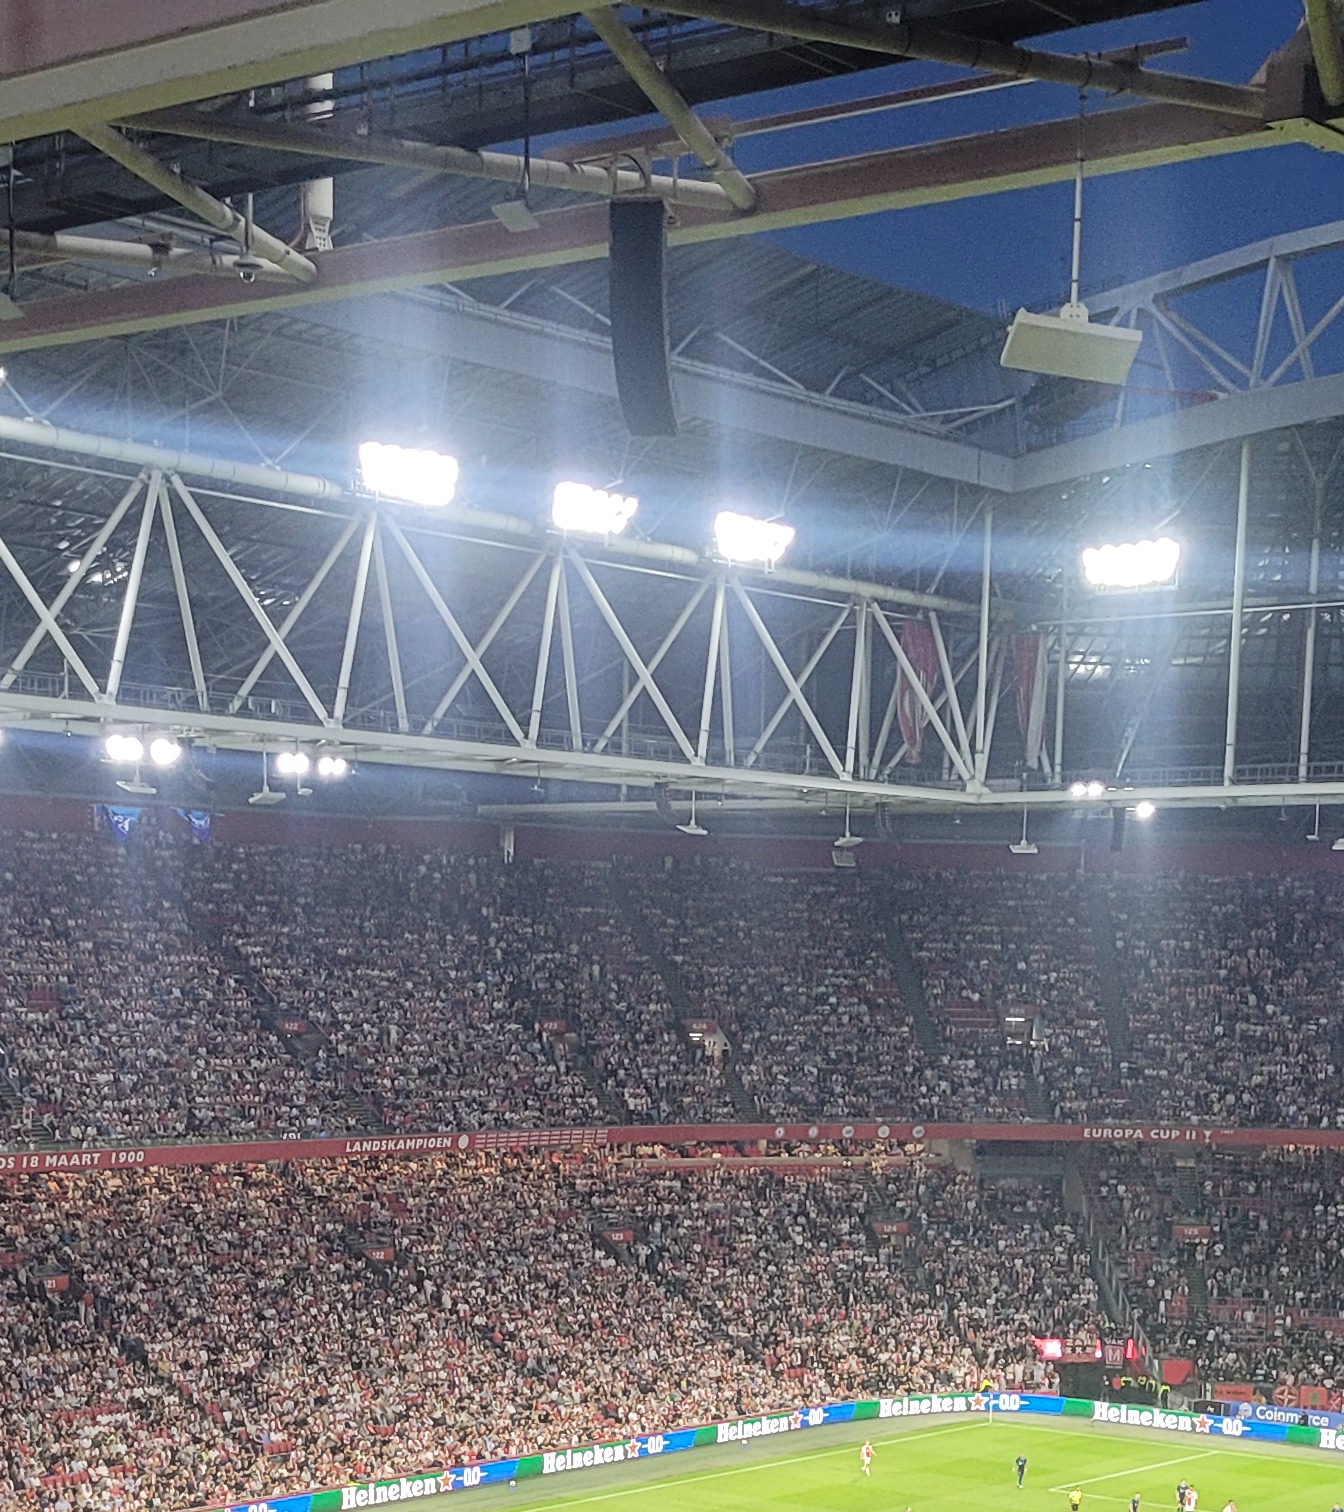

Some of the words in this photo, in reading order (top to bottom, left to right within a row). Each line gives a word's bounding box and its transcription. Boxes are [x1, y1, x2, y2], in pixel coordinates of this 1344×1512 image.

[345, 1136, 452, 1153] LANDSKAMPIOEN
[1083, 1128, 1144, 1139] EUROPA
[1150, 1129, 1180, 1140] CUP
[20, 1154, 40, 1170] 18
[44, 1152, 102, 1168] MAART
[110, 1150, 146, 1165] 1900
[878, 1394, 966, 1417] Heineken
[1092, 1401, 1194, 1432] Heineken
[1256, 1405, 1330, 1427] Coinmrce
[716, 1414, 789, 1444] Heineken
[542, 1444, 625, 1475] Heineken
[340, 1477, 438, 1511] Heineken
